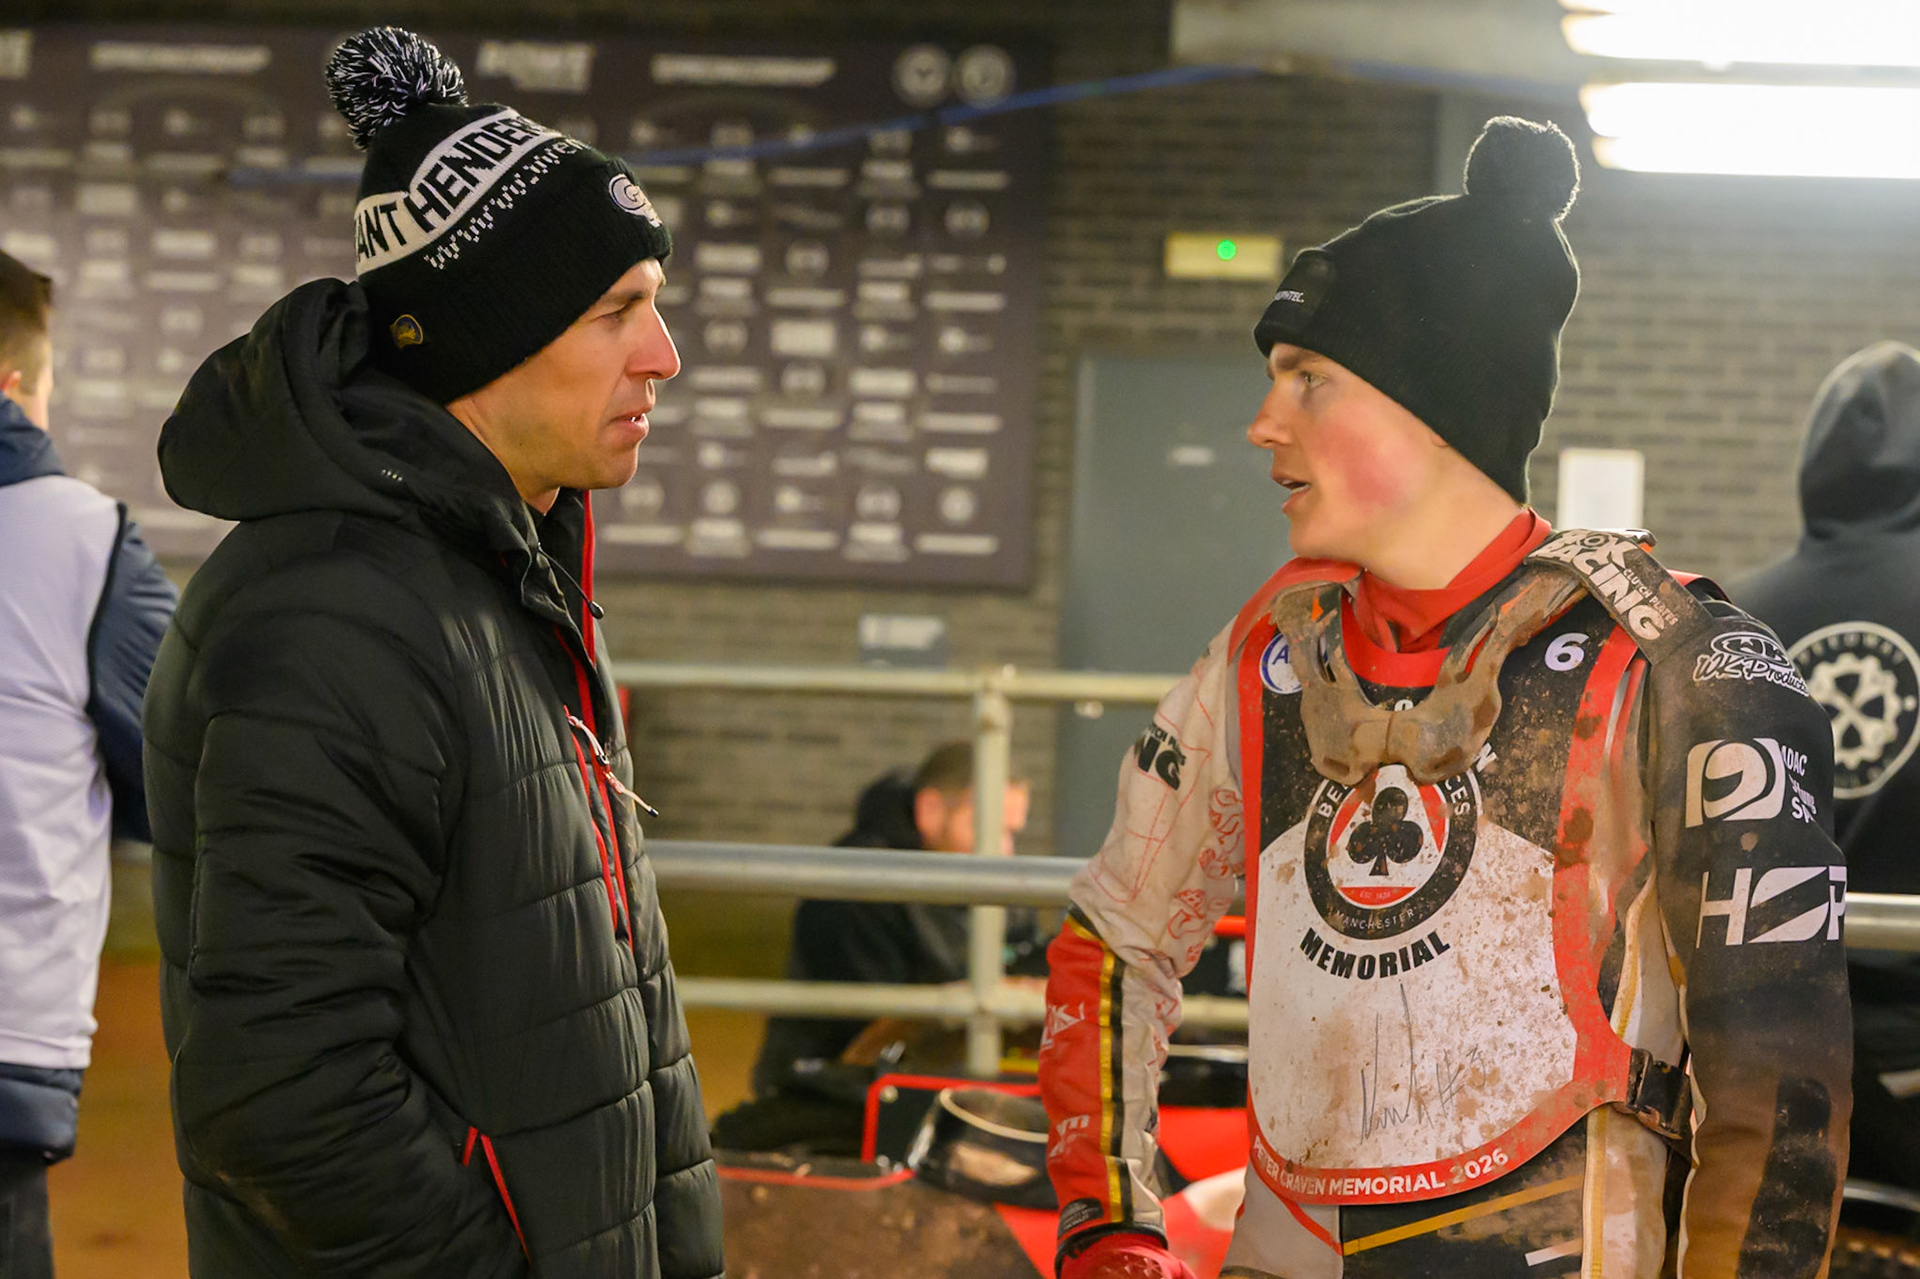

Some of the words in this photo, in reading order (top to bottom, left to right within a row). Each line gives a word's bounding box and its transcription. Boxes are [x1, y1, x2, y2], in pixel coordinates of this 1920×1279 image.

[1544, 632, 1590, 672] 6
[1300, 927, 1450, 980] MEMORIAL
[1280, 1169, 1327, 1196] CRAVEN
[1329, 1171, 1446, 1196] MEMORIAL
[1449, 1147, 1509, 1185] 2026
